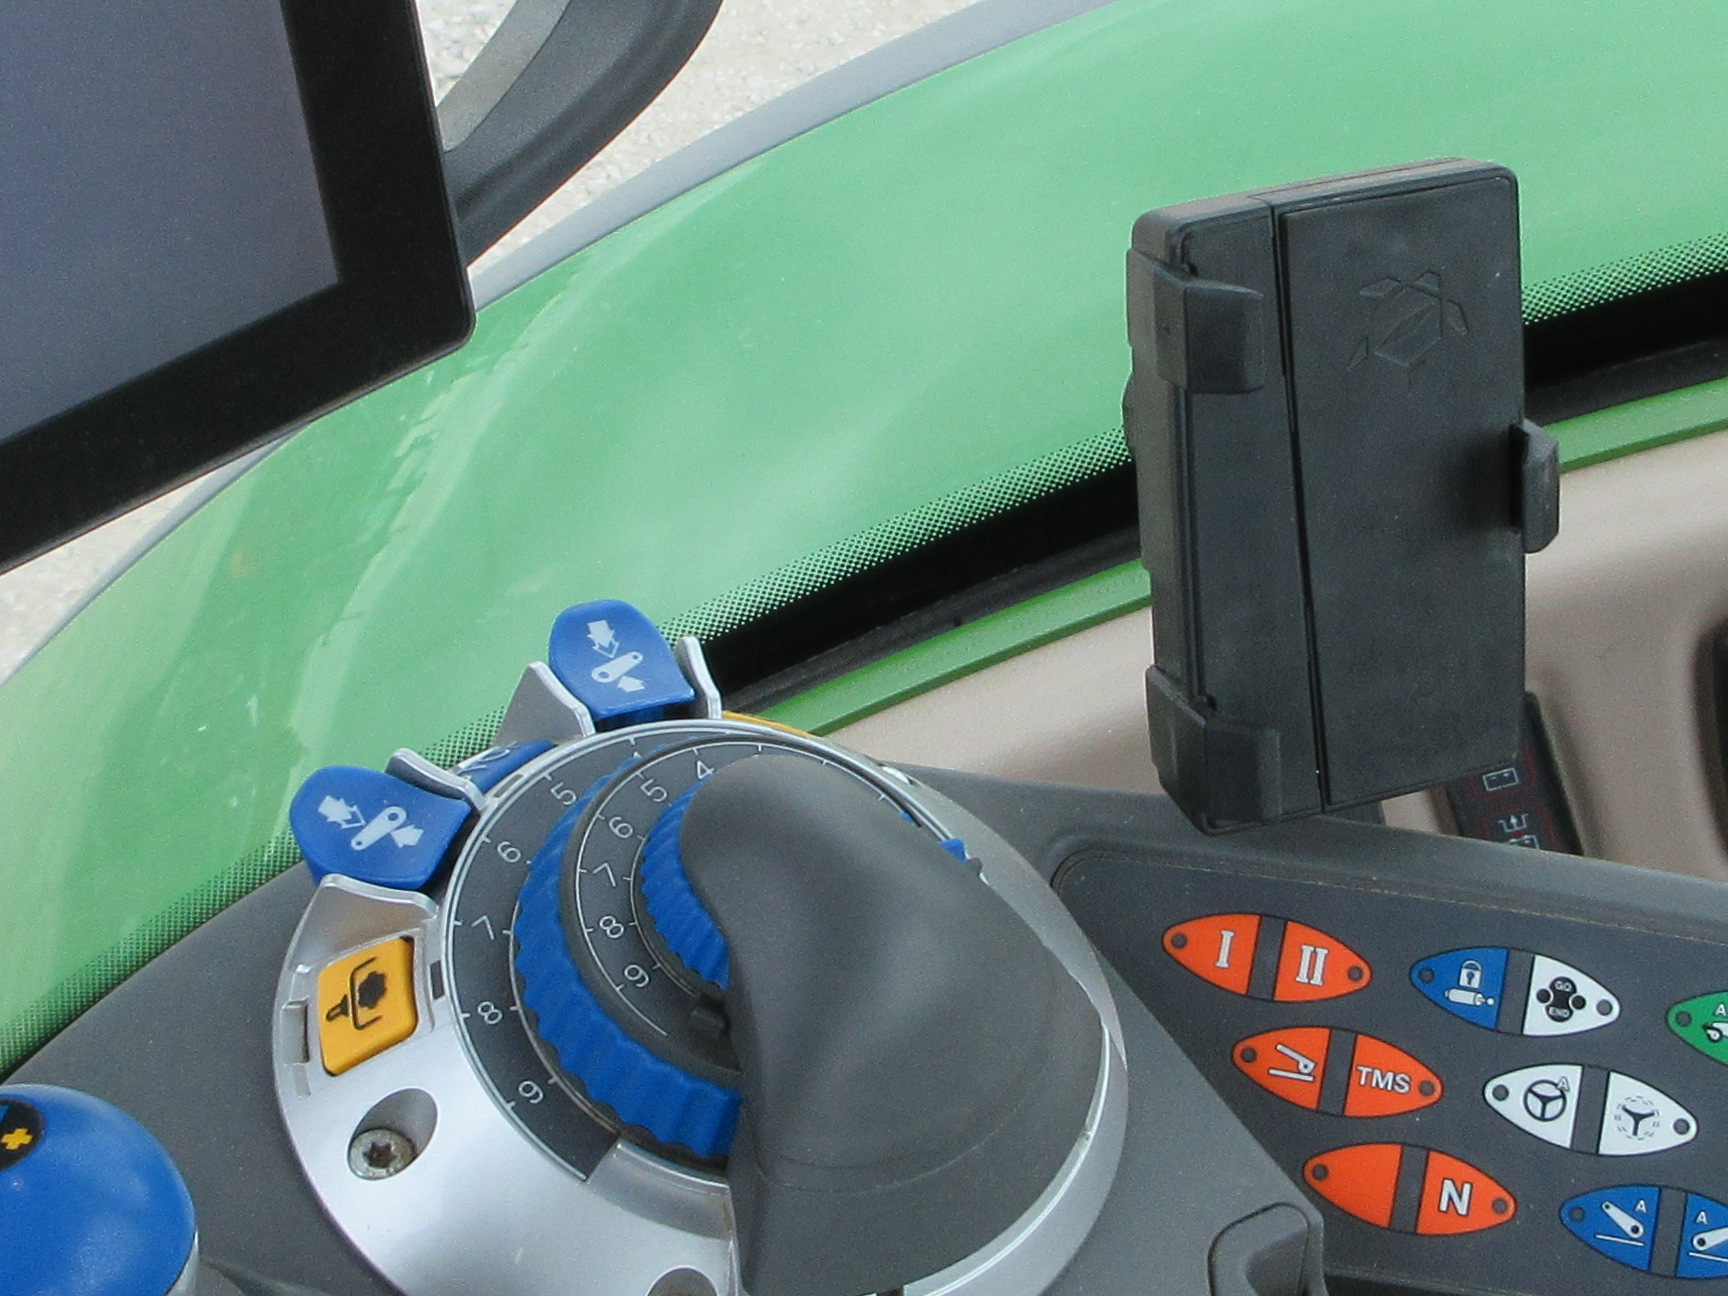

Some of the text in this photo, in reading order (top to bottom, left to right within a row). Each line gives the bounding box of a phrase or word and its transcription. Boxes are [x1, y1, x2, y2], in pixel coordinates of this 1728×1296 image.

[549, 781, 577, 805] 5
[639, 778, 668, 804] 5
[608, 816, 634, 840] 6
[496, 840, 522, 864] 6
[598, 915, 625, 939] 8
[477, 1001, 503, 1026] 8
[1712, 1003, 1728, 1018] A
[1356, 1065, 1411, 1096] TMS
[1555, 1076, 1571, 1093] A
[1438, 1176, 1473, 1217] N
[1633, 1198, 1648, 1213] A
[1695, 1210, 1710, 1225] A
